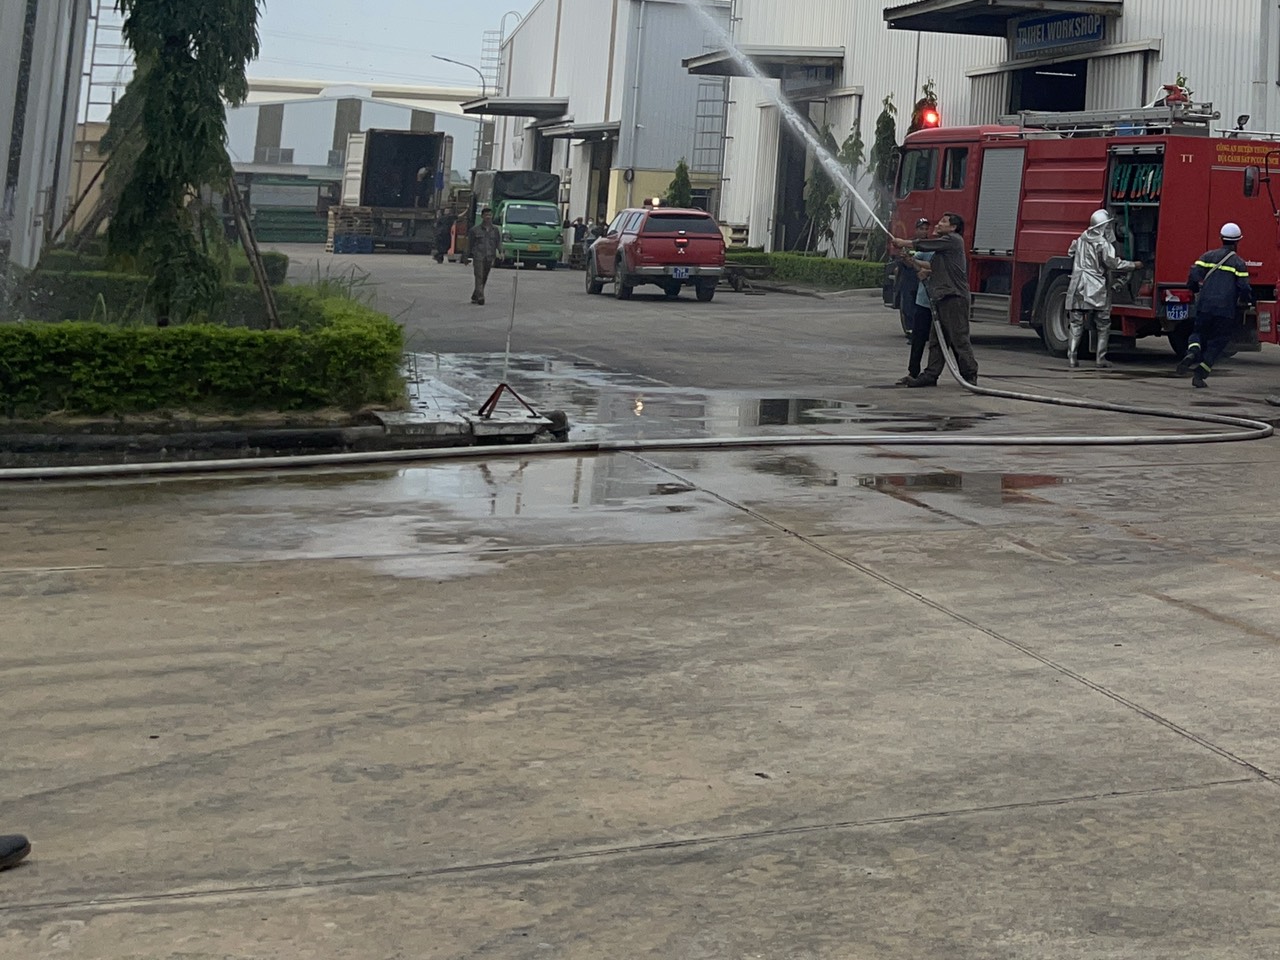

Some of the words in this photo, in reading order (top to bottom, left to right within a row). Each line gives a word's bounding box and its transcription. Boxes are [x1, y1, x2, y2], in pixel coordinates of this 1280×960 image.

[1018, 23, 1045, 46] TAIHEI
[1046, 14, 1101, 41] WORKSHOP
[1180, 153, 1194, 164] TT
